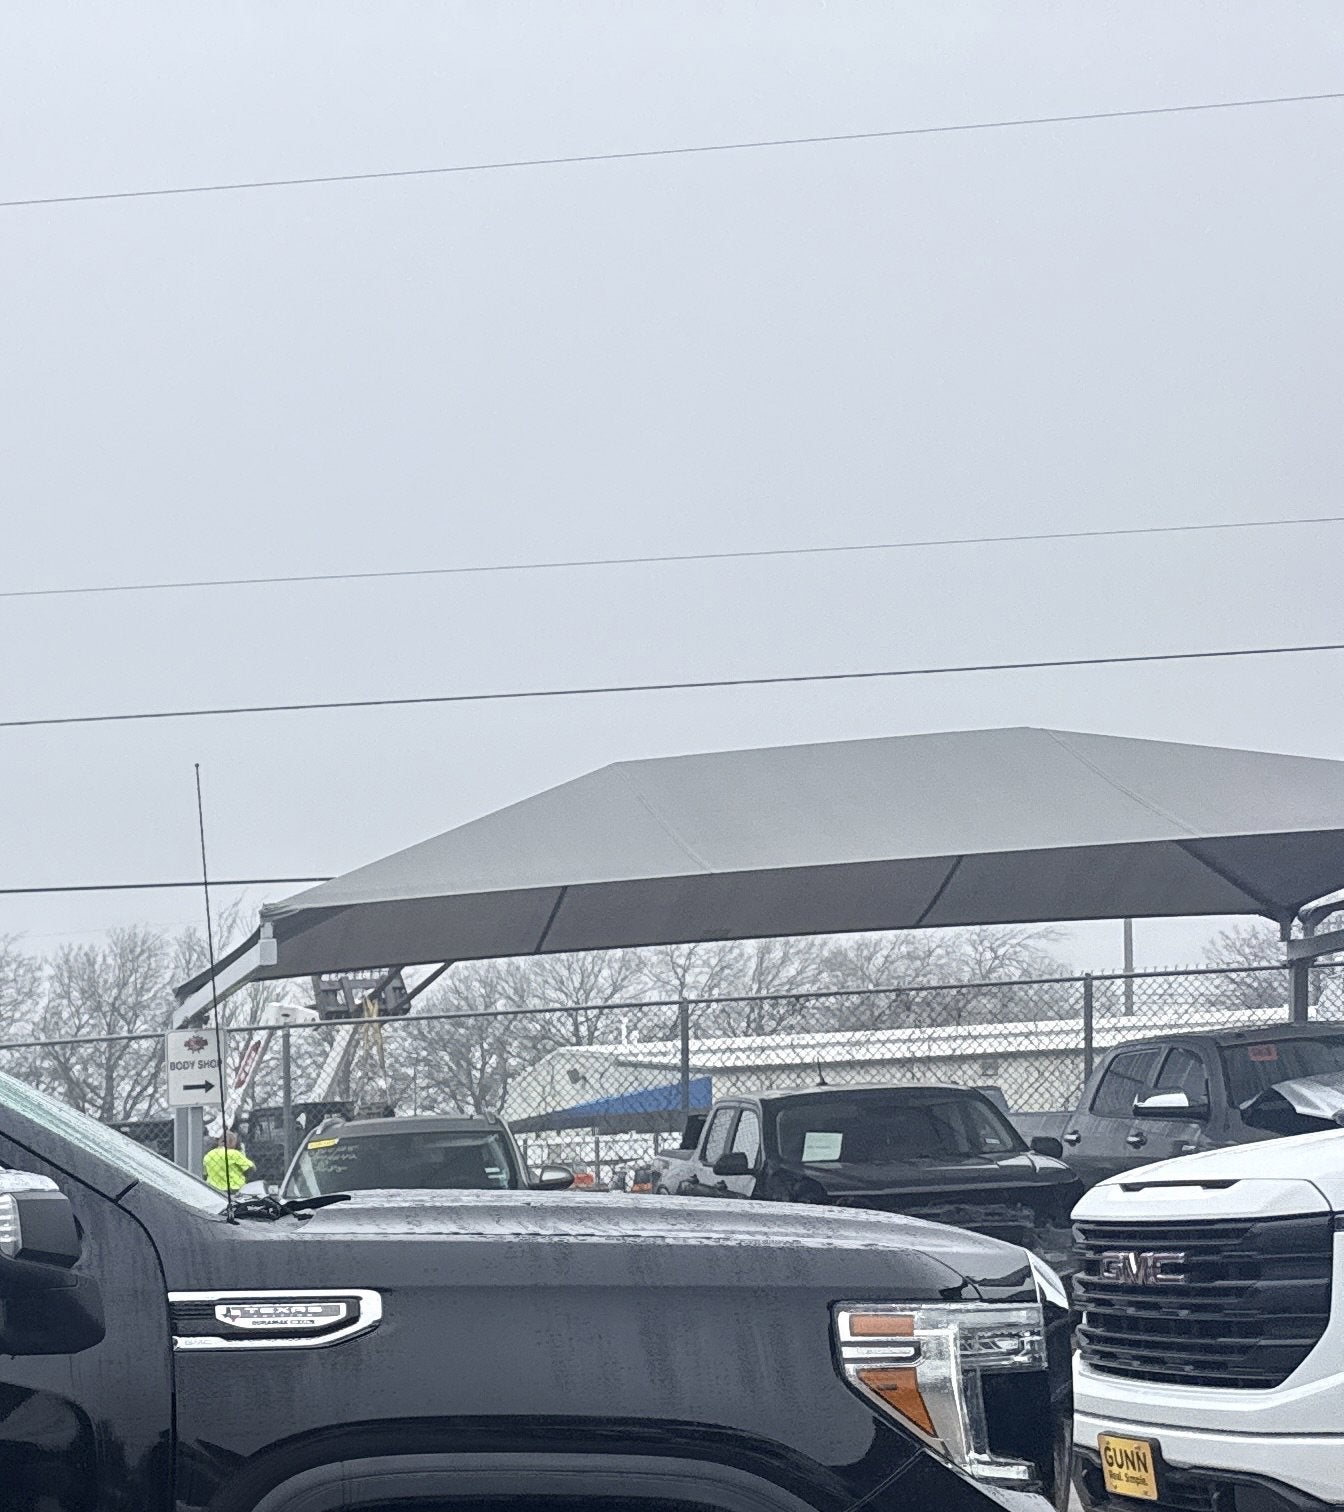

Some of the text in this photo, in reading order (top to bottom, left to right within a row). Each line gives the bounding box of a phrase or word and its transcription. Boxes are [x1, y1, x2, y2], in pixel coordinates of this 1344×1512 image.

[169, 1060, 195, 1071] BODY
[1100, 1251, 1185, 1286] GMC
[243, 1306, 323, 1314] TEXAS
[1104, 1445, 1149, 1474] GUNN
